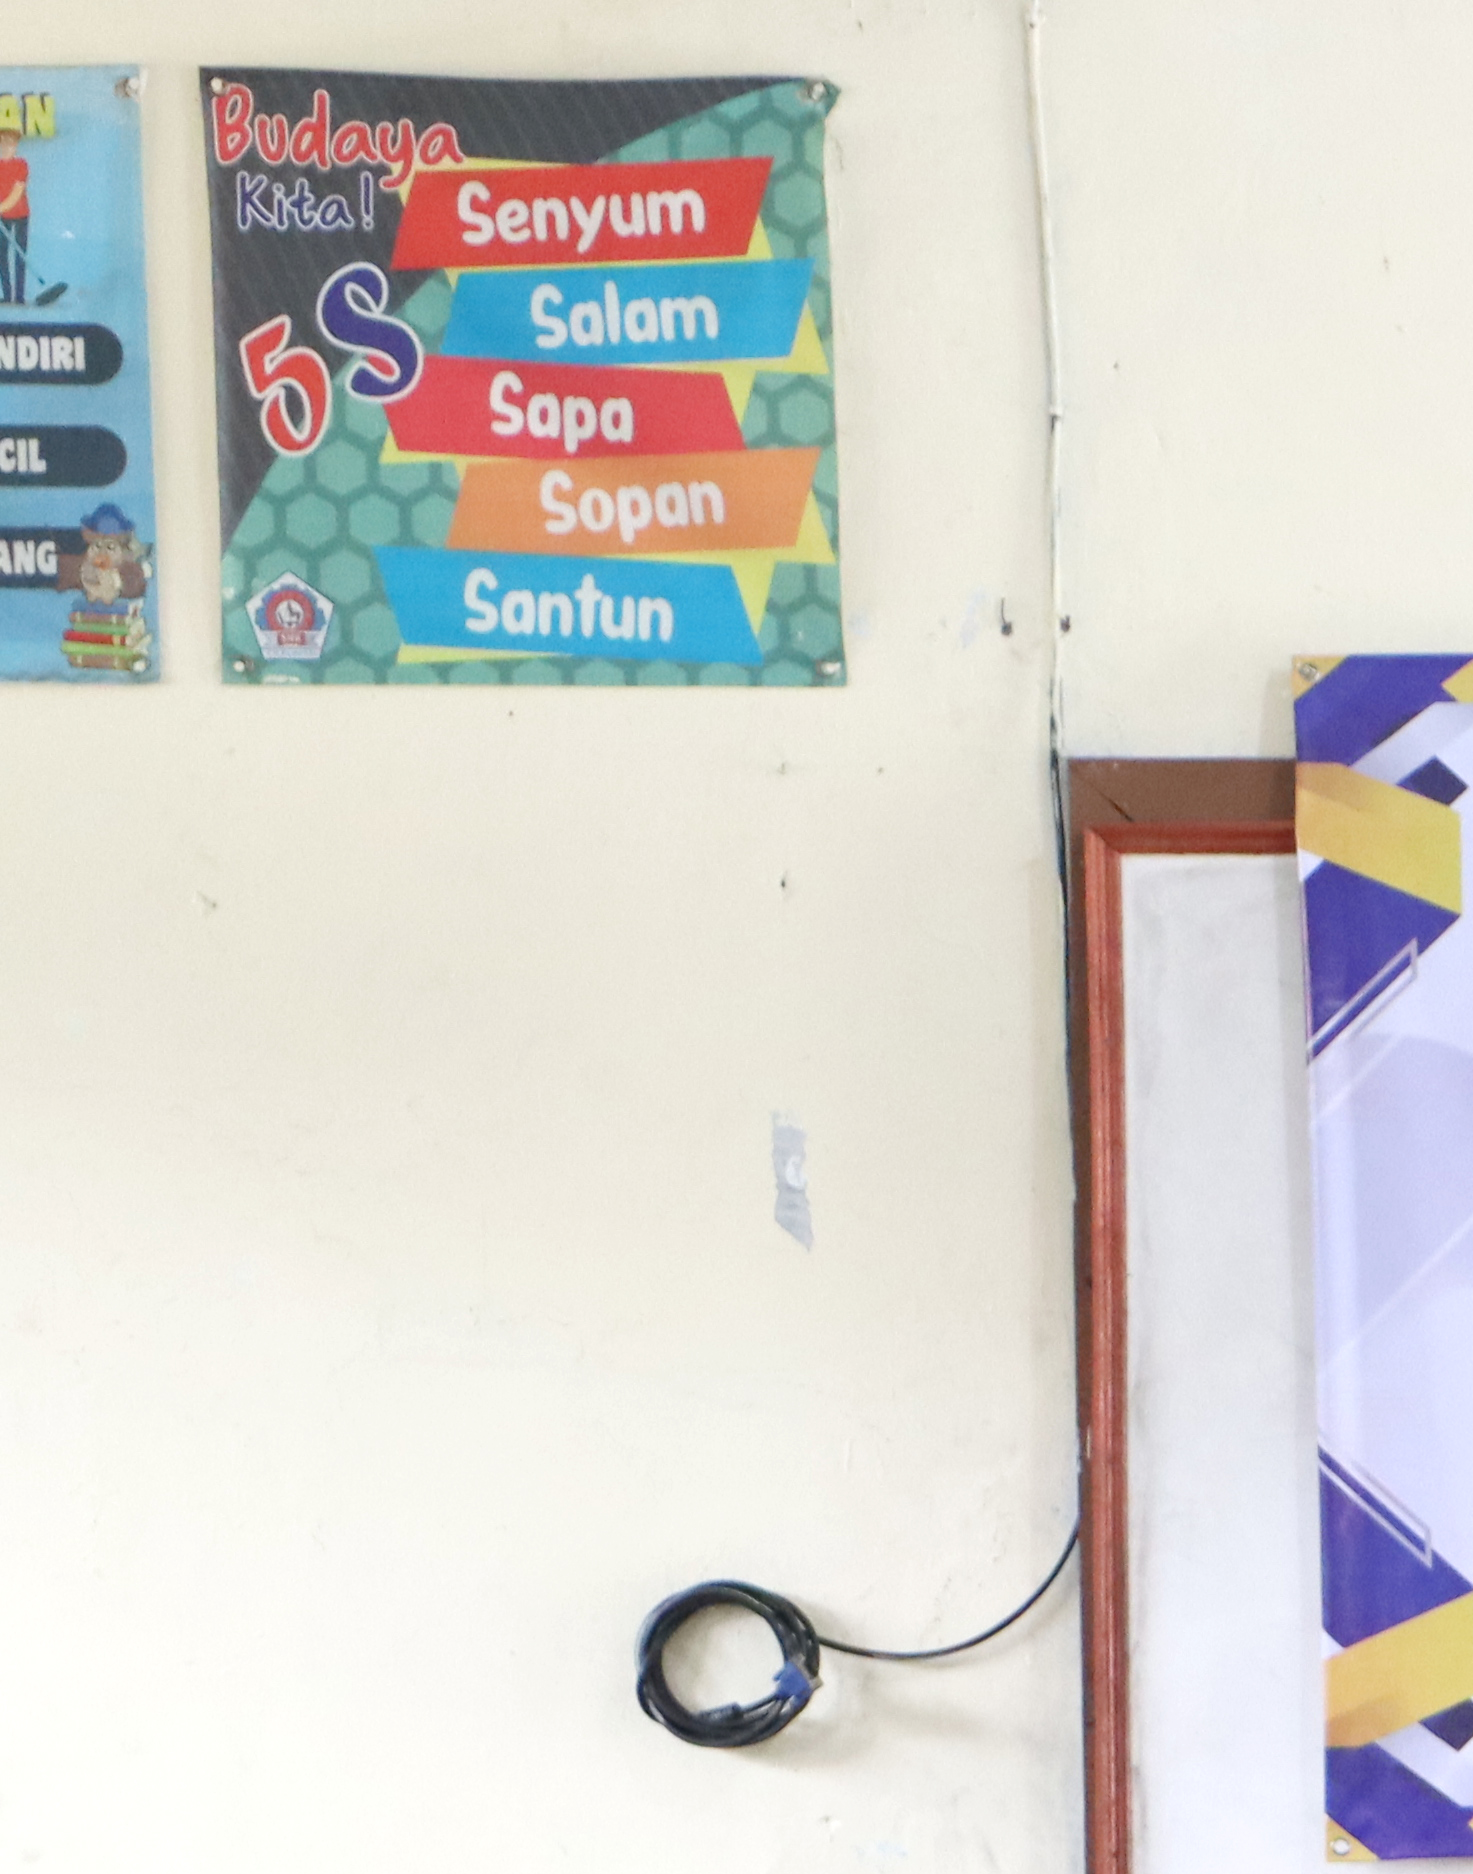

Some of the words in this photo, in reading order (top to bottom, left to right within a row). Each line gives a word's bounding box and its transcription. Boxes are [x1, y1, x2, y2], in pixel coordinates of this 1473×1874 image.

[211, 84, 465, 189] Budaya
[236, 172, 374, 231] Kita!
[457, 181, 706, 252] Senyum
[531, 282, 719, 349] Salam
[489, 371, 635, 453] Sapa
[540, 470, 726, 542] Sopan
[463, 567, 674, 641] Santun
